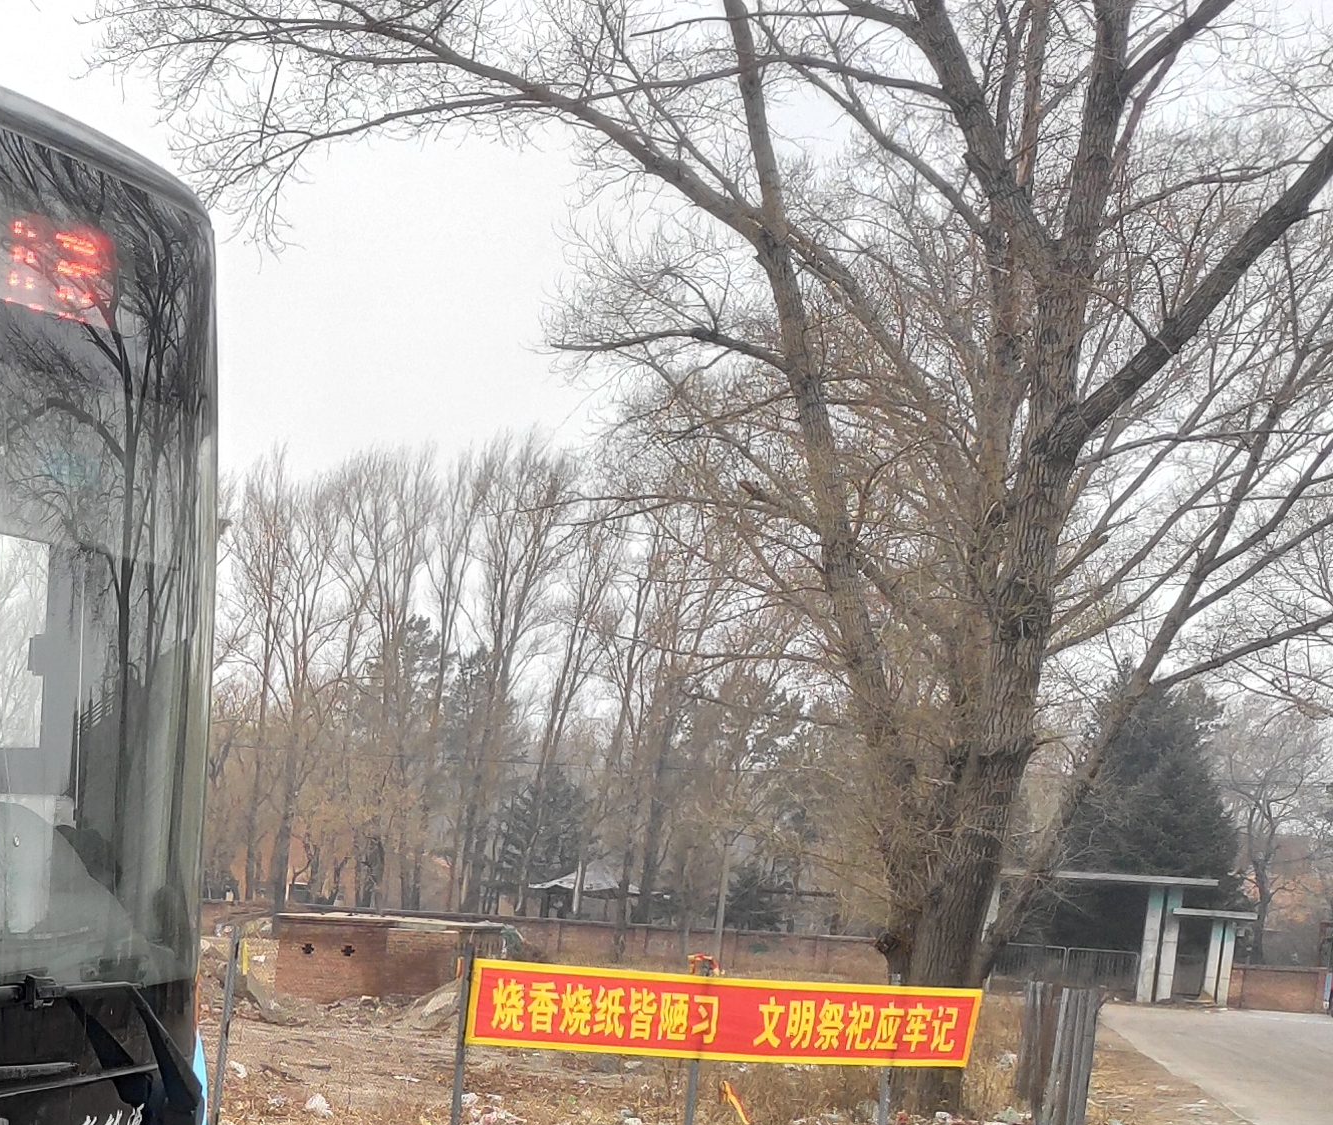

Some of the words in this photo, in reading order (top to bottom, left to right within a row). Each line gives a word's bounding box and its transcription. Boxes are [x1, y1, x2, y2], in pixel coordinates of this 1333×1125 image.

[490, 977, 719, 1045] 烧香烧纸皆陋习
[753, 996, 959, 1053] 文明祭祀应牢记
